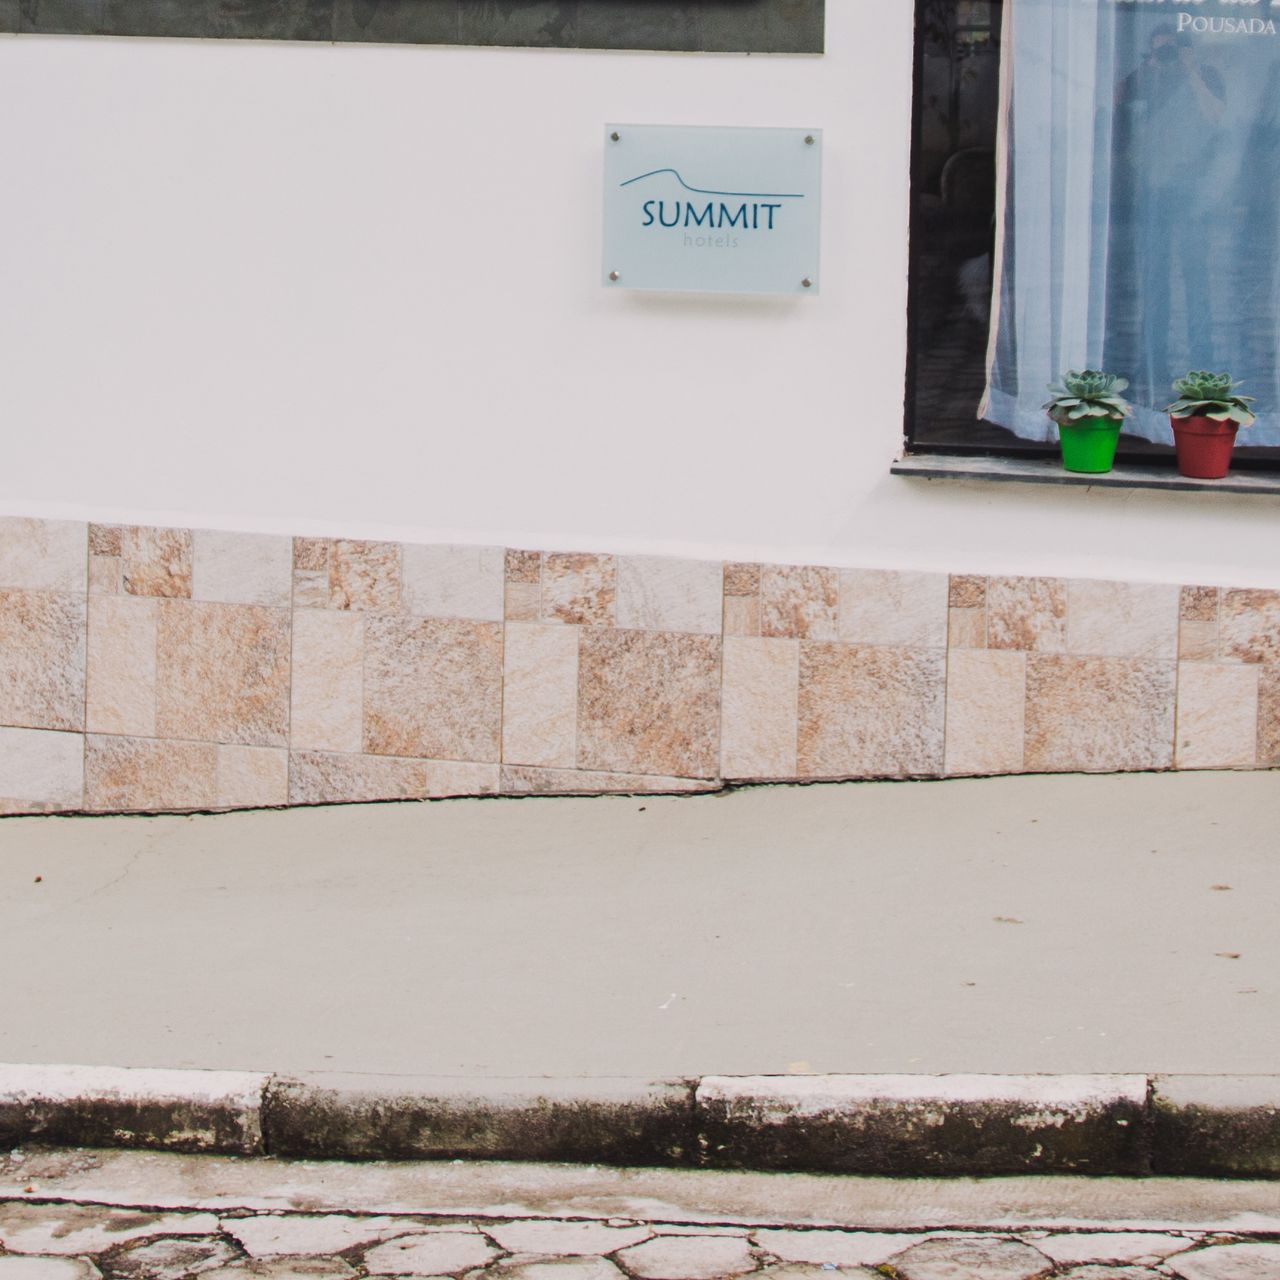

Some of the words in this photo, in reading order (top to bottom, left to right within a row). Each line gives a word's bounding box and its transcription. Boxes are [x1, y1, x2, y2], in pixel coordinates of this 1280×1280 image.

[1177, 12, 1277, 35] POUSADA
[642, 200, 782, 229] SUMMIT
[682, 232, 739, 248] hotels
